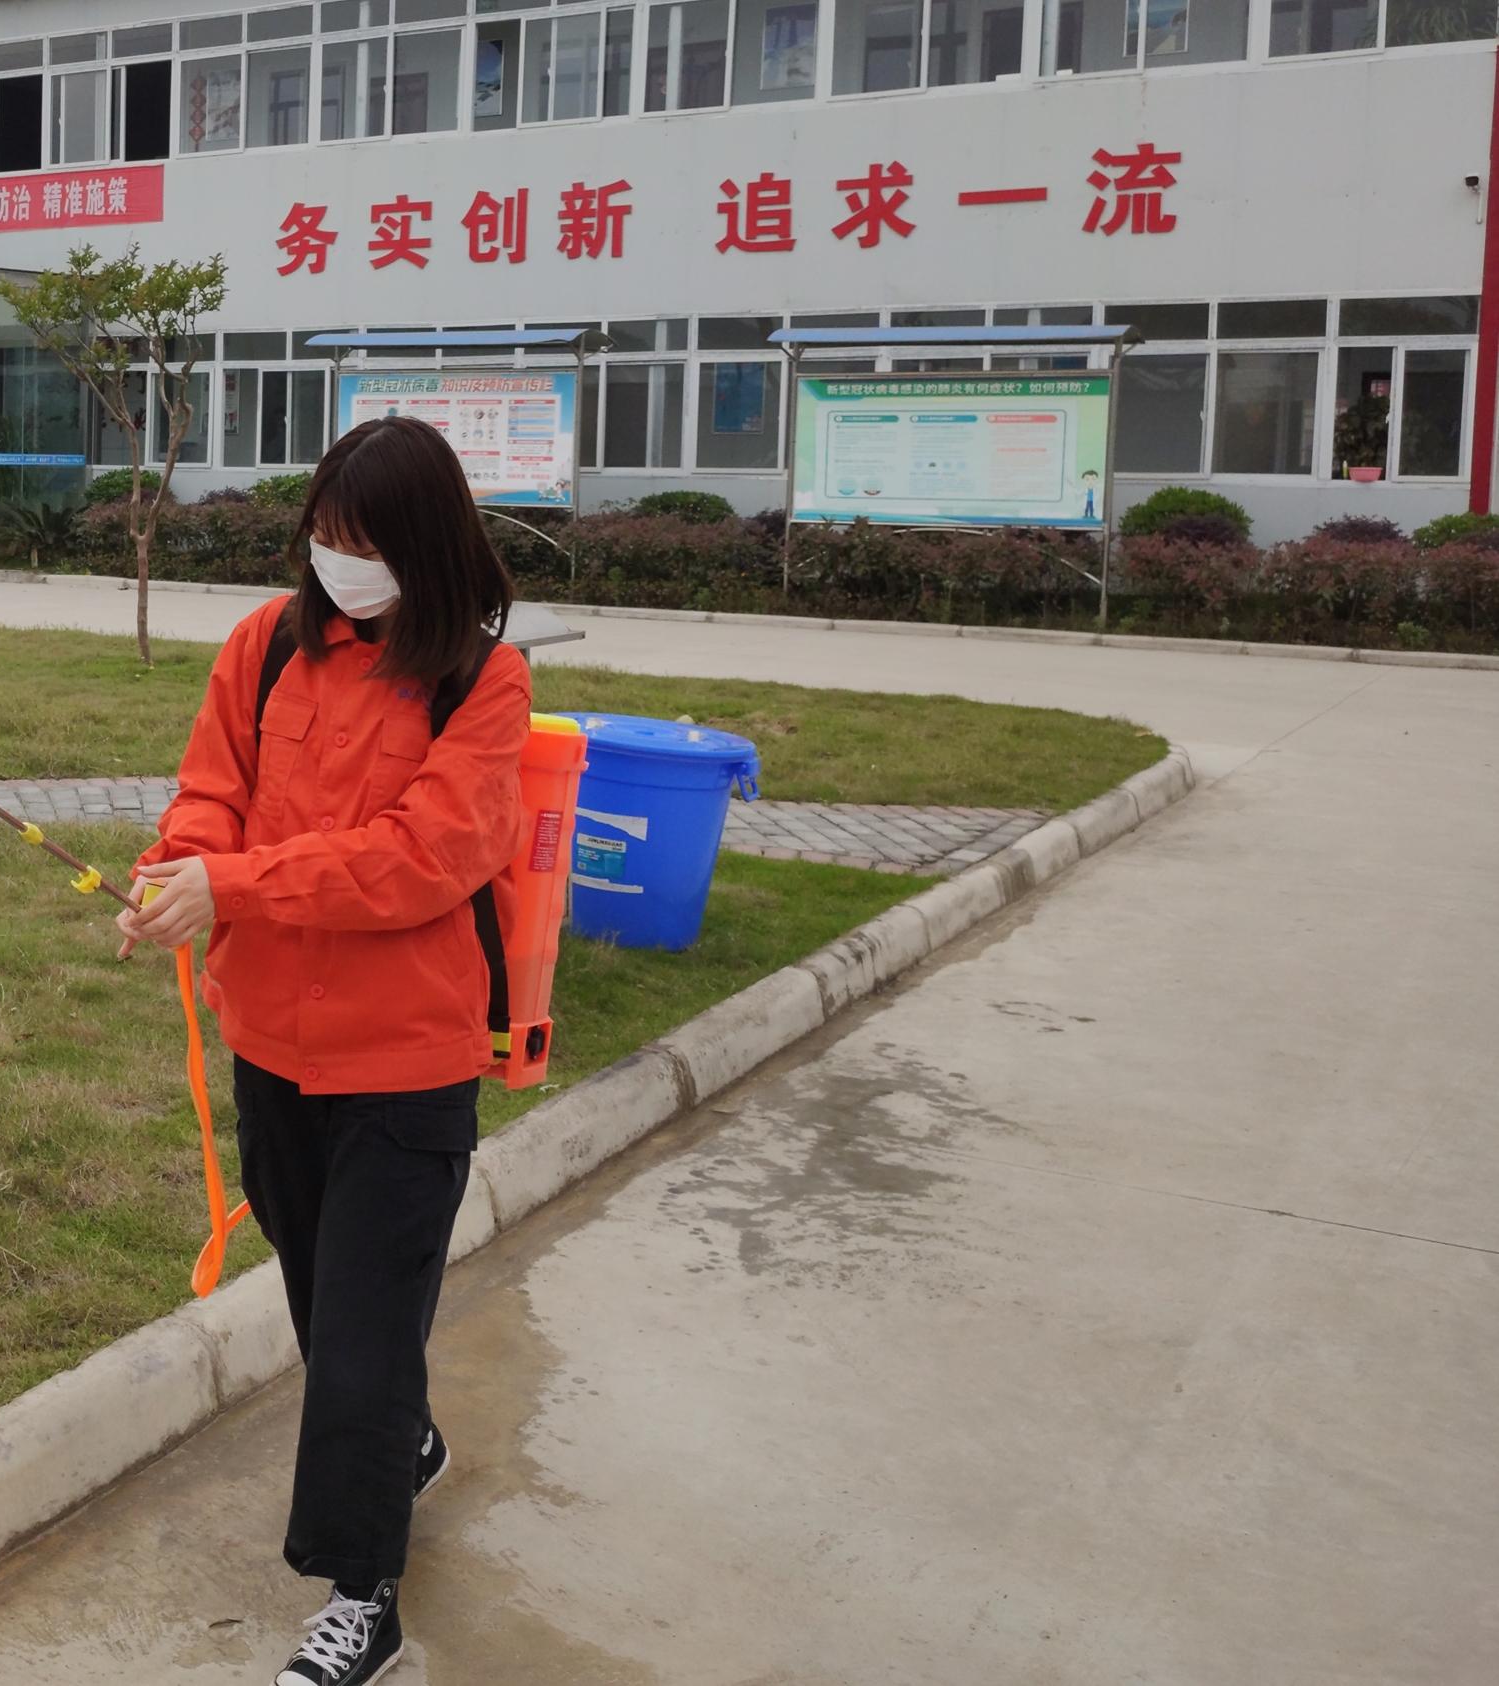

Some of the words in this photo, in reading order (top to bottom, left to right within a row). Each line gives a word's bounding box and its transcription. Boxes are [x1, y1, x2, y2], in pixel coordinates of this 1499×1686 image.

[42, 176, 128, 219] 精准施策
[275, 180, 632, 277] 务实创新
[715, 142, 1183, 254] 追求一流
